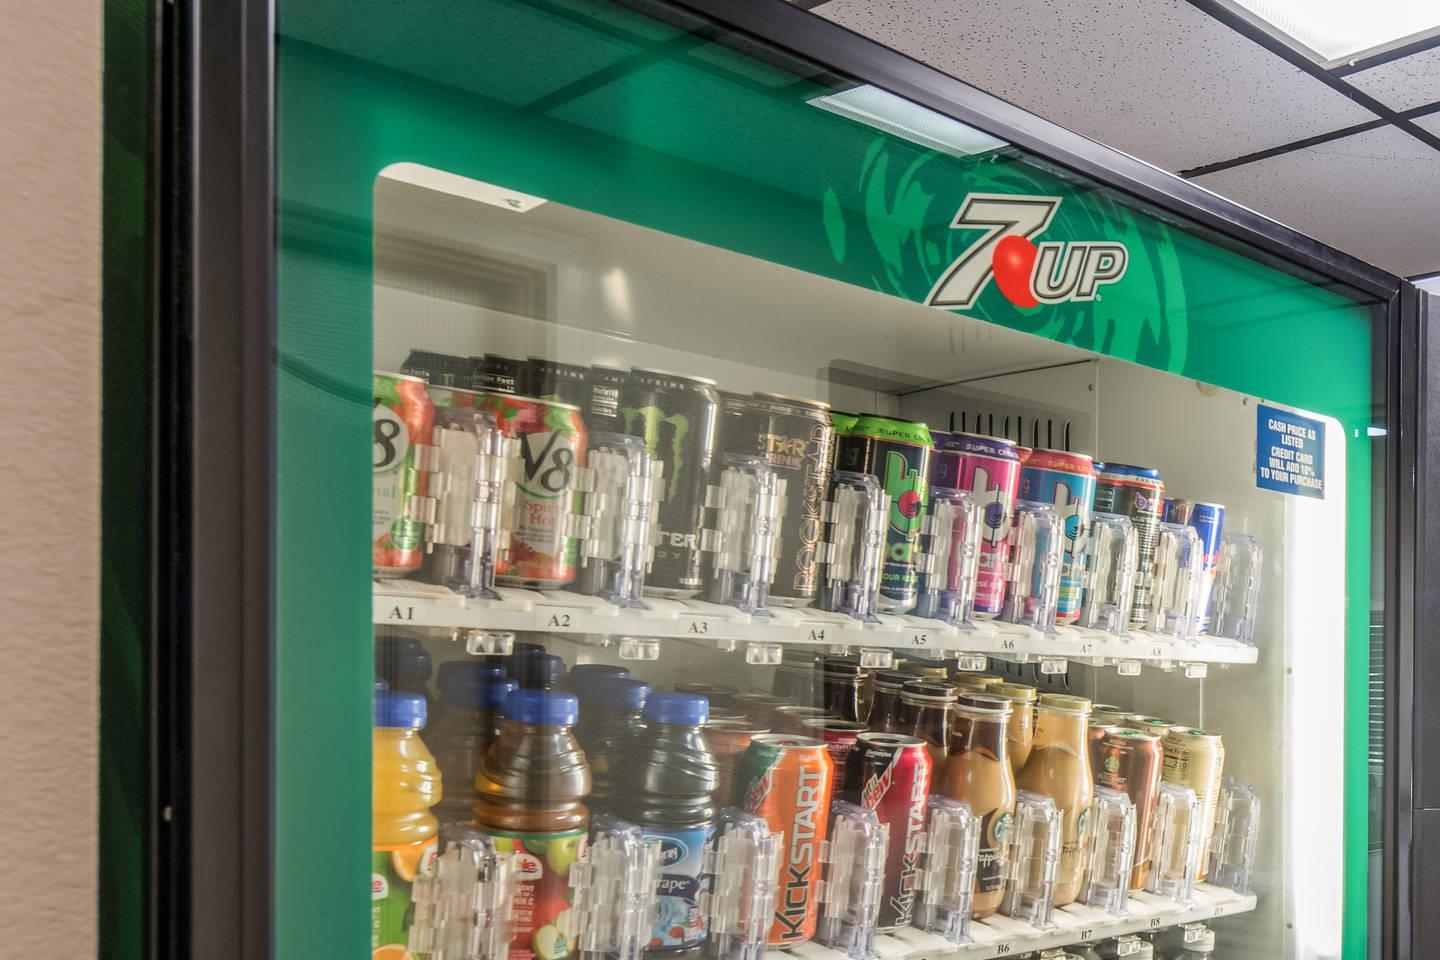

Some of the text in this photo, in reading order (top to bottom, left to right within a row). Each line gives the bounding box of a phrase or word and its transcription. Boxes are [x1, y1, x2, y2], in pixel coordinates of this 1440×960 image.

[1268, 418, 1316, 441] CASH PRICE AS
[1281, 433, 1303, 448] LISTED
[966, 443, 995, 453] SUPER
[516, 429, 574, 493] V8
[1271, 445, 1313, 465] CREDIT CARD
[1268, 457, 1315, 477] WILL ADD 10%
[1260, 466, 1322, 490] TO YOUR PURCHASE
[388, 606, 414, 620] A1
[548, 614, 570, 627] A2
[688, 622, 707, 634] A3
[808, 629, 825, 641] A4
[911, 634, 927, 645] A5
[1001, 639, 1015, 649] A6
[1080, 644, 1092, 653] A7
[1080, 928, 1092, 940] B7
[997, 943, 1010, 954] B6
